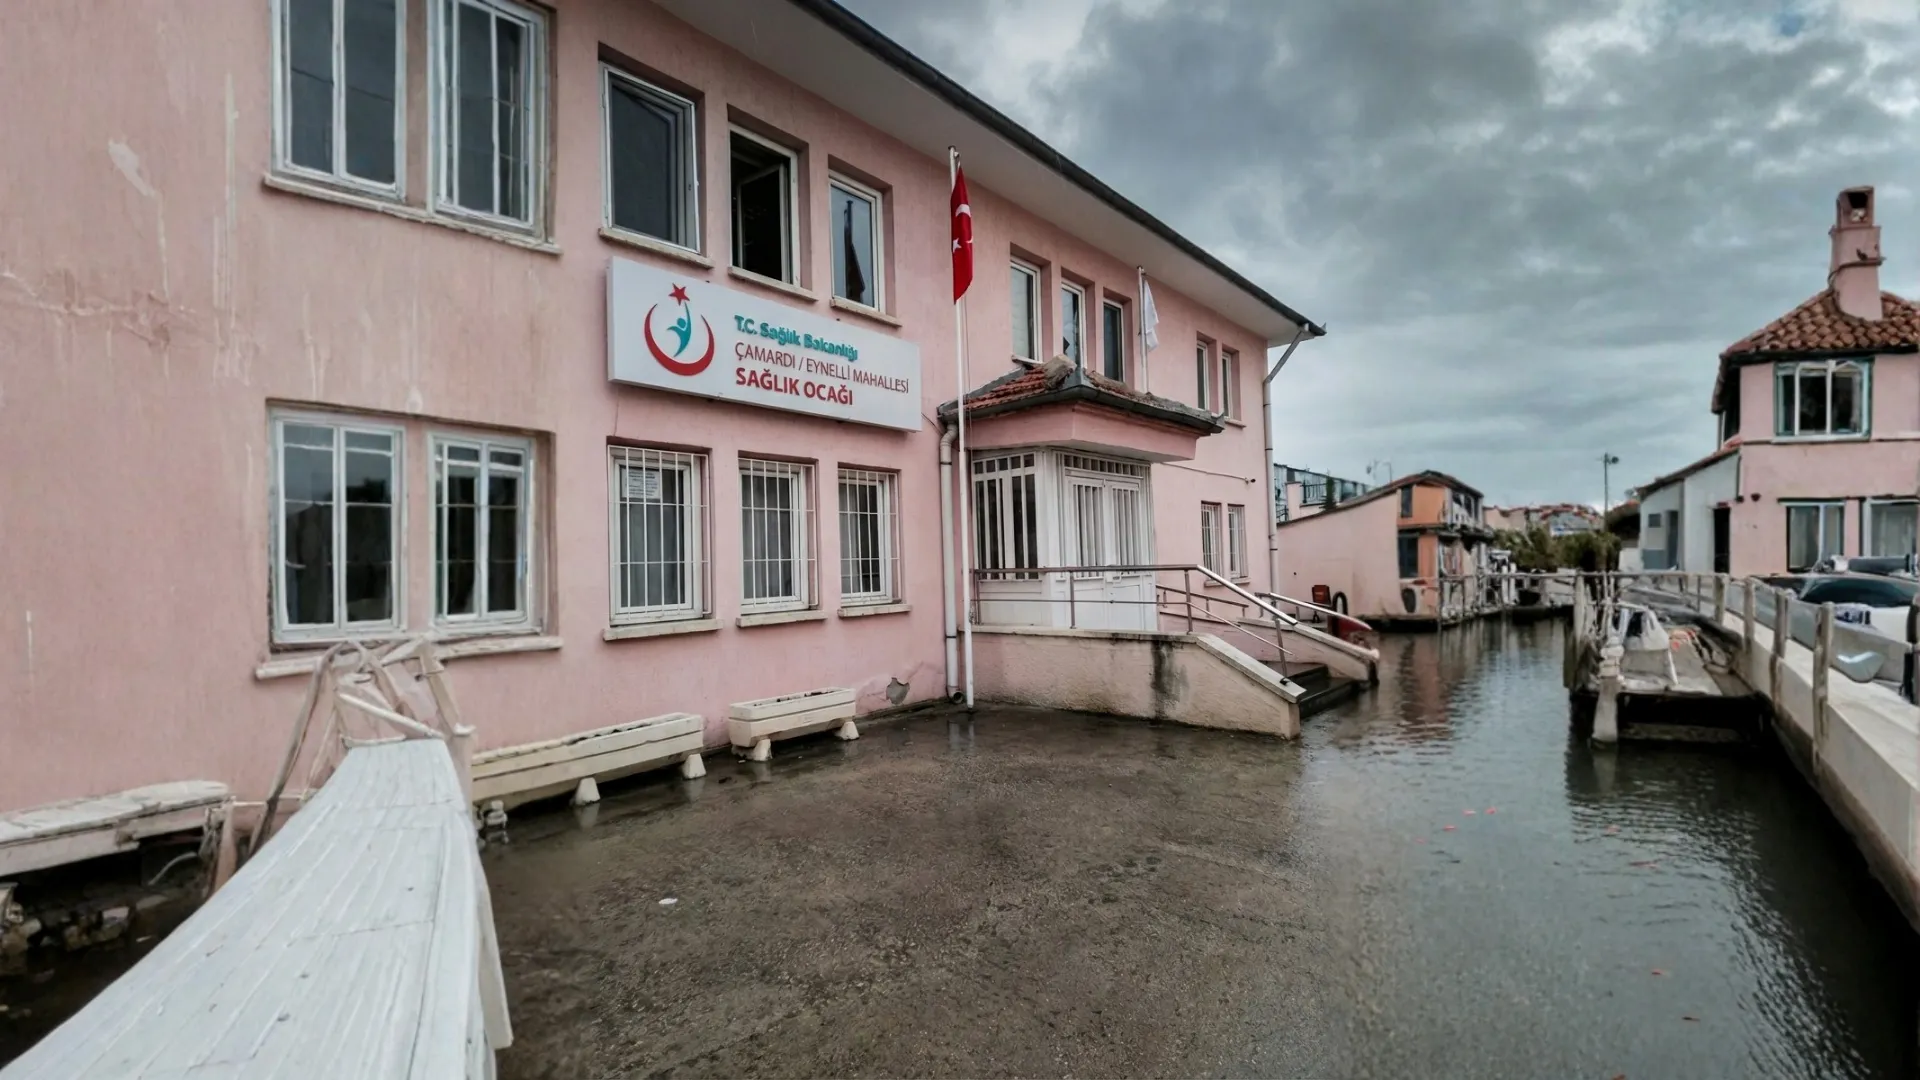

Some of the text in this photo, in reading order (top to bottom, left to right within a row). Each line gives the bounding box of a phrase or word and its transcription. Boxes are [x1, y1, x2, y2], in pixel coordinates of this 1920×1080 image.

[734, 315, 757, 335] T.C.
[760, 323, 801, 346] Sağlık
[735, 342, 795, 368] ÇAMARDI
[806, 358, 850, 380] EYNELLİ
[853, 369, 909, 393] MAHALLESİ
[736, 367, 853, 405] SAĞLIK OCAĞI
